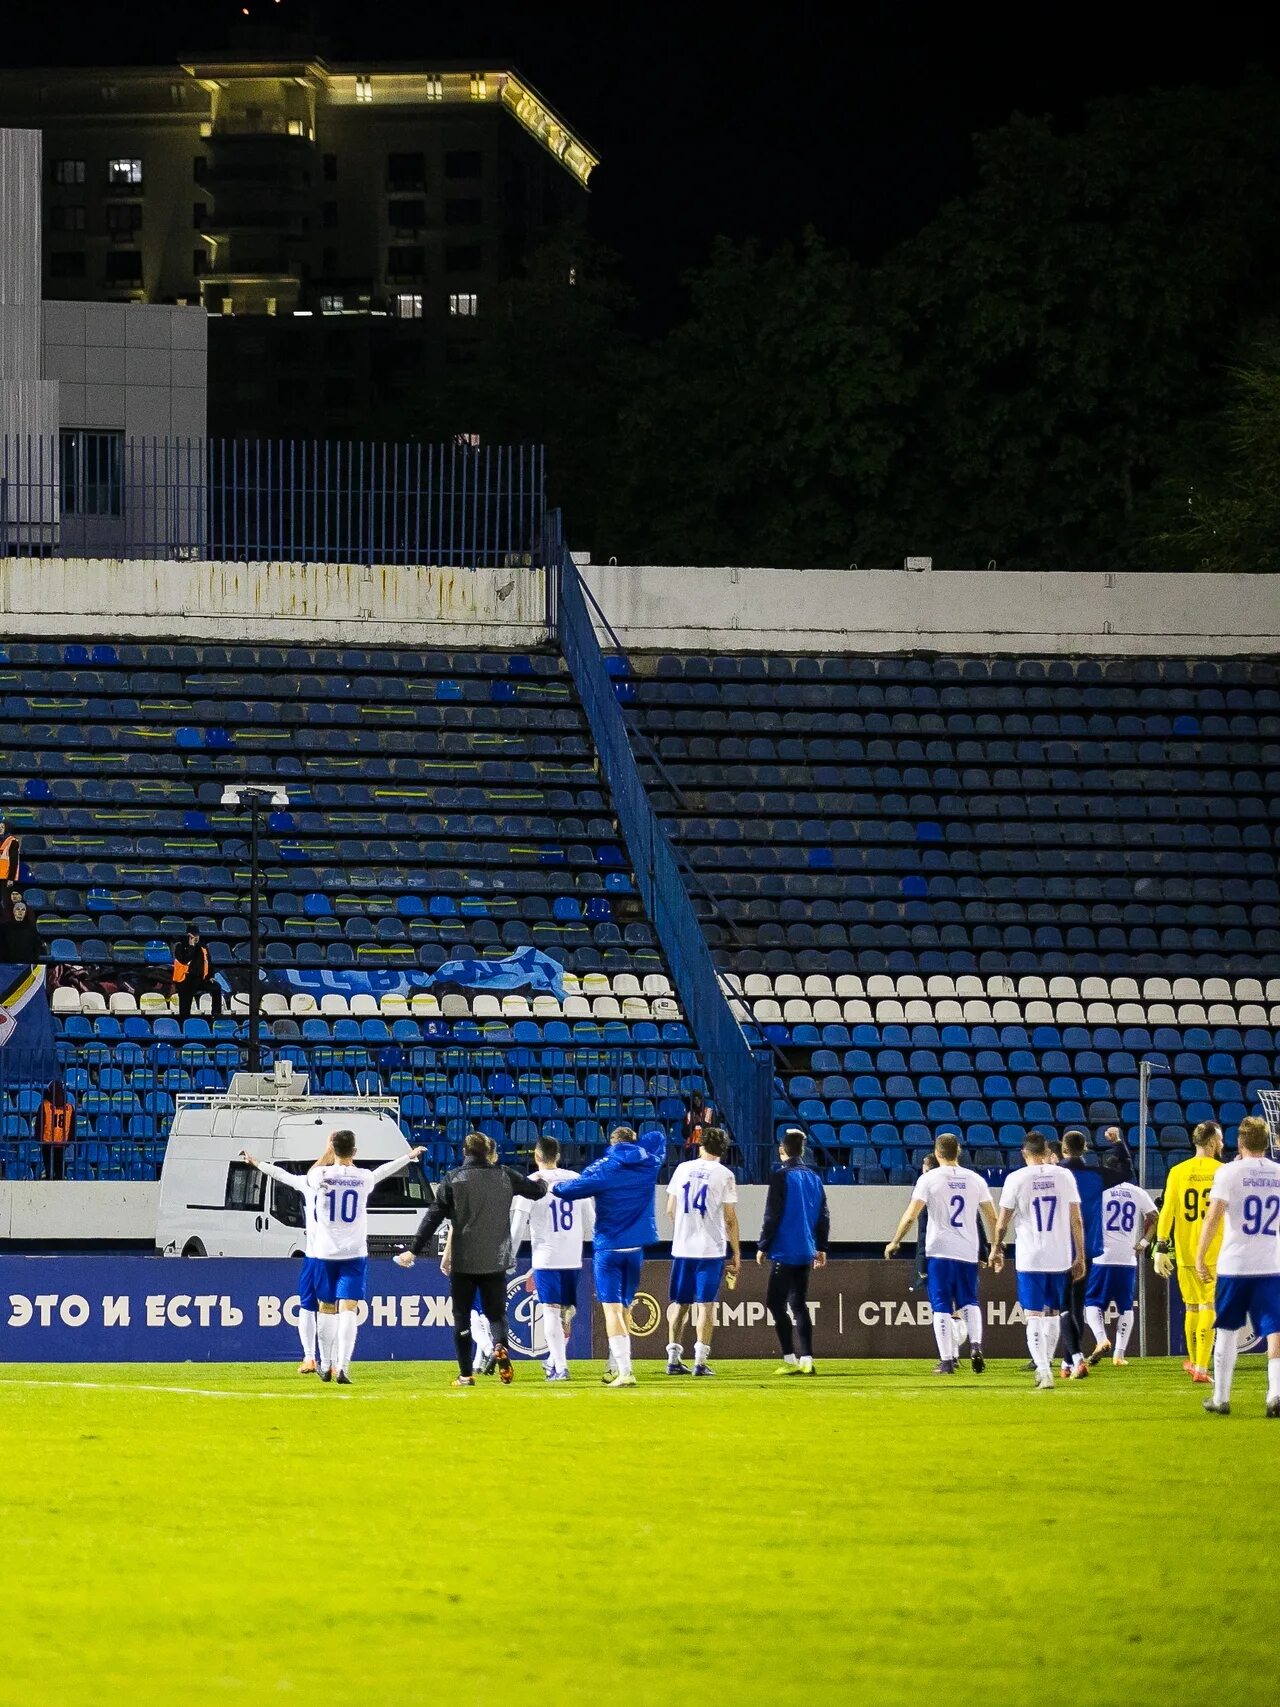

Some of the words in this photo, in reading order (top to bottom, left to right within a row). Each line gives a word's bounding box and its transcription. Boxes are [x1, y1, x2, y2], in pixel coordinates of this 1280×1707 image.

[324, 1189, 359, 1223] 10
[549, 1198, 574, 1233] 18
[682, 1181, 709, 1219] 14
[950, 1194, 965, 1228] 2
[1032, 1195, 1057, 1232] 17
[1106, 1199, 1136, 1232] 28
[1242, 1194, 1280, 1237] 92
[7, 1294, 91, 1328] ЭТО
[102, 1295, 131, 1328] И
[145, 1294, 243, 1327] ЕСТЬ
